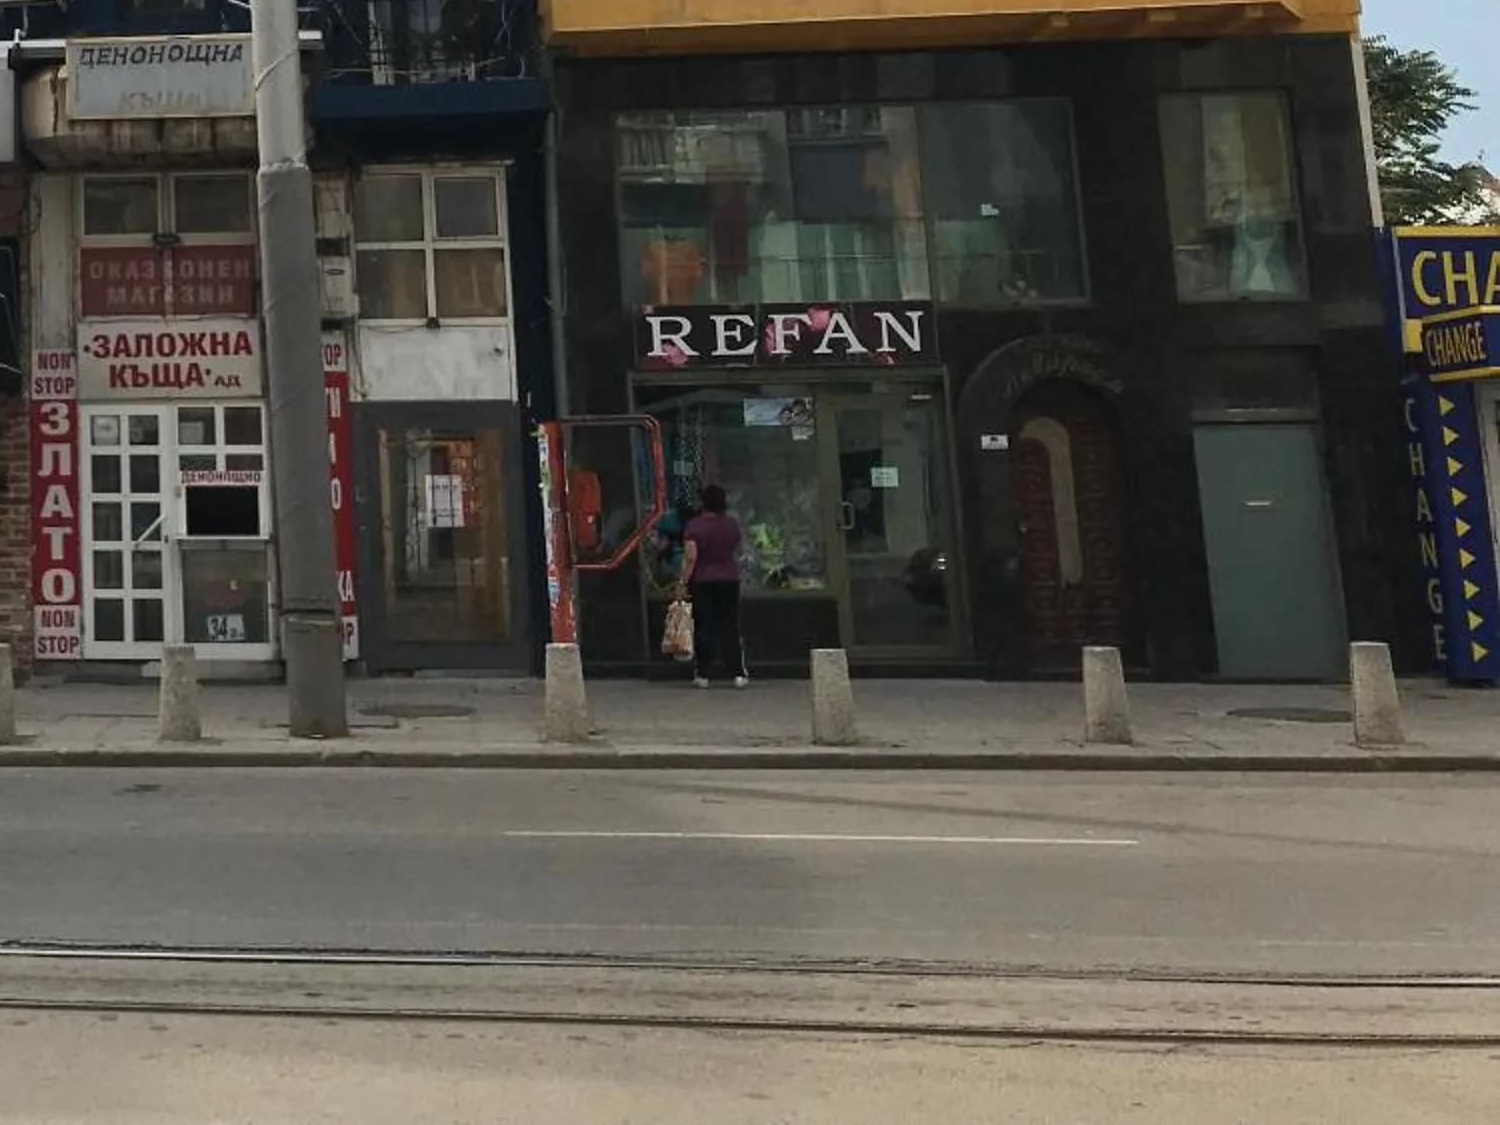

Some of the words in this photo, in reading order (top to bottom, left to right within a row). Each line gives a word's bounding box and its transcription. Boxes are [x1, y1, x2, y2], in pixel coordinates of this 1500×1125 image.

[80, 44, 243, 69] ДЕНОНОЩНА
[92, 331, 253, 359] ЗАЛОЖНА
[645, 310, 925, 357] REFAN
[1425, 321, 1488, 367] CHANGE
[38, 352, 71, 370] NON
[35, 377, 75, 394] STOP
[109, 362, 205, 389] КЪЩА
[37, 401, 76, 604] ЗЛАТО
[41, 610, 75, 628] NON
[37, 636, 79, 654] STOP
